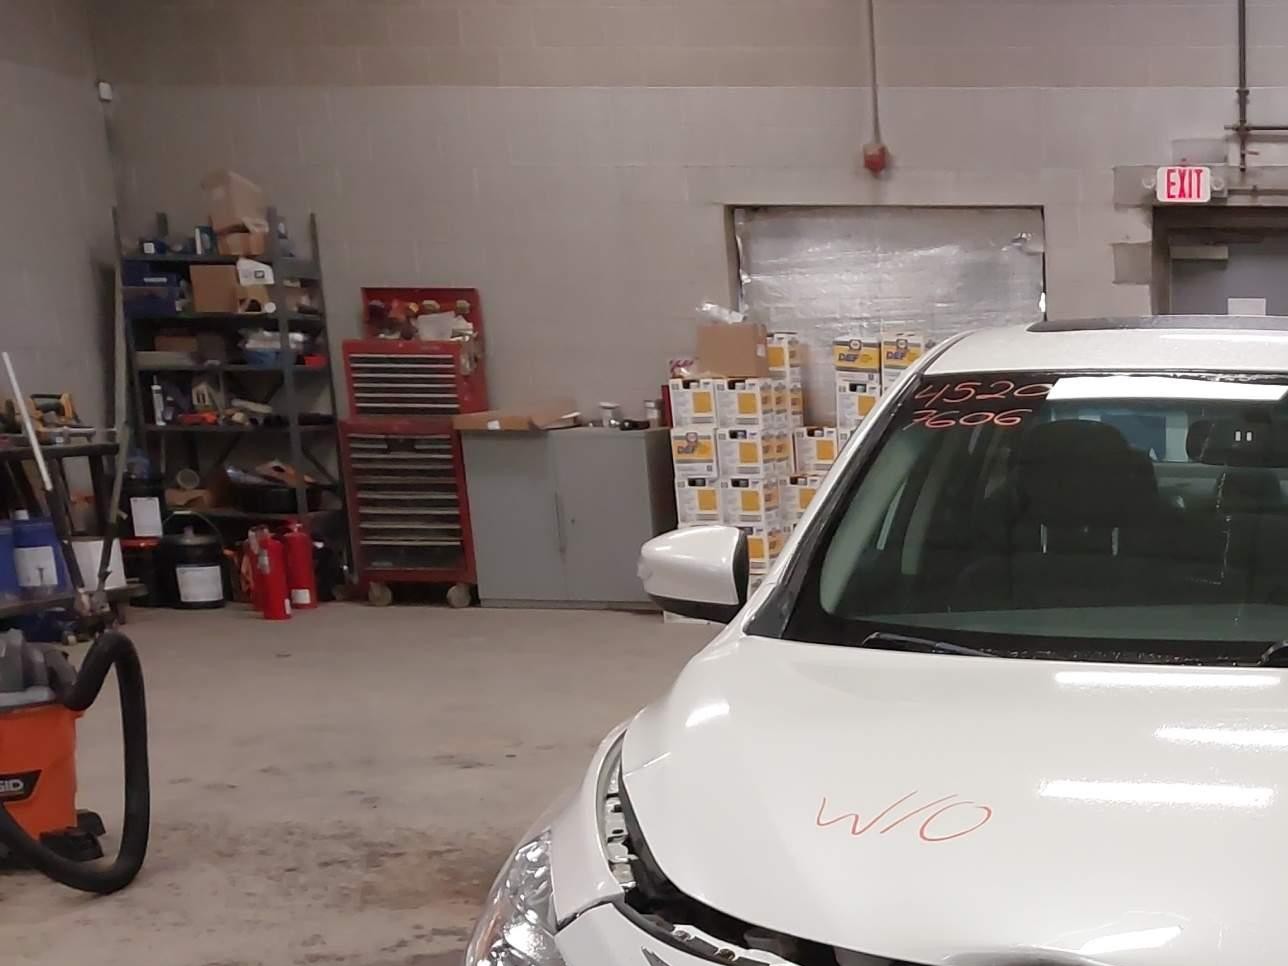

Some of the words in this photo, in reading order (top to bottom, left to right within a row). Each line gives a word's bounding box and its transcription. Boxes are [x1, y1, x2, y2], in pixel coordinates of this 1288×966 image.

[1167, 169, 1203, 199] EXIT
[838, 353, 859, 362] DEF
[886, 351, 905, 360] DEF
[914, 380, 1055, 407] 4520
[902, 409, 1033, 431] 7606
